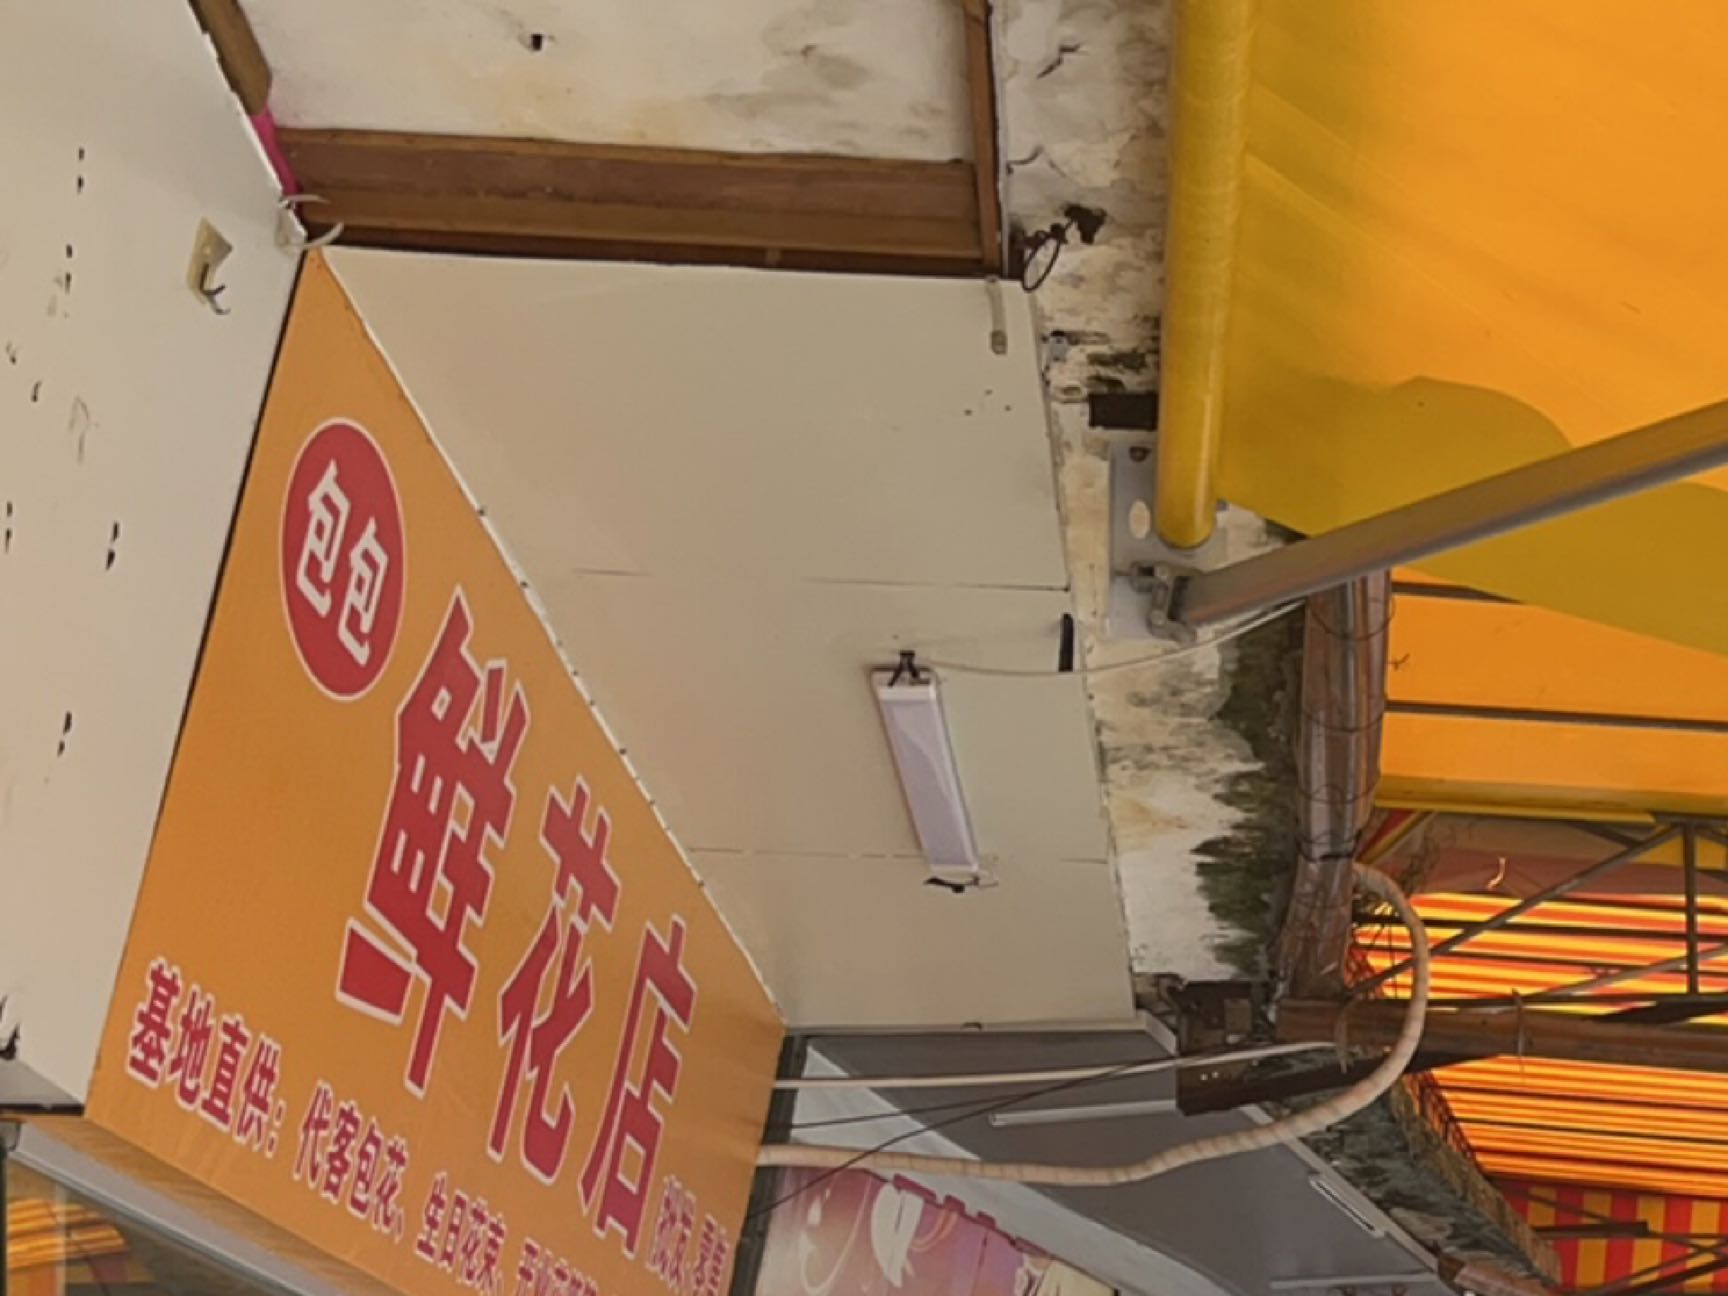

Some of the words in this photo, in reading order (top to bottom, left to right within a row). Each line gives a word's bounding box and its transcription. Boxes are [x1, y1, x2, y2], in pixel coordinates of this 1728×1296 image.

[297, 460, 388, 666] 包包
[336, 584, 697, 1258] 鲜花店
